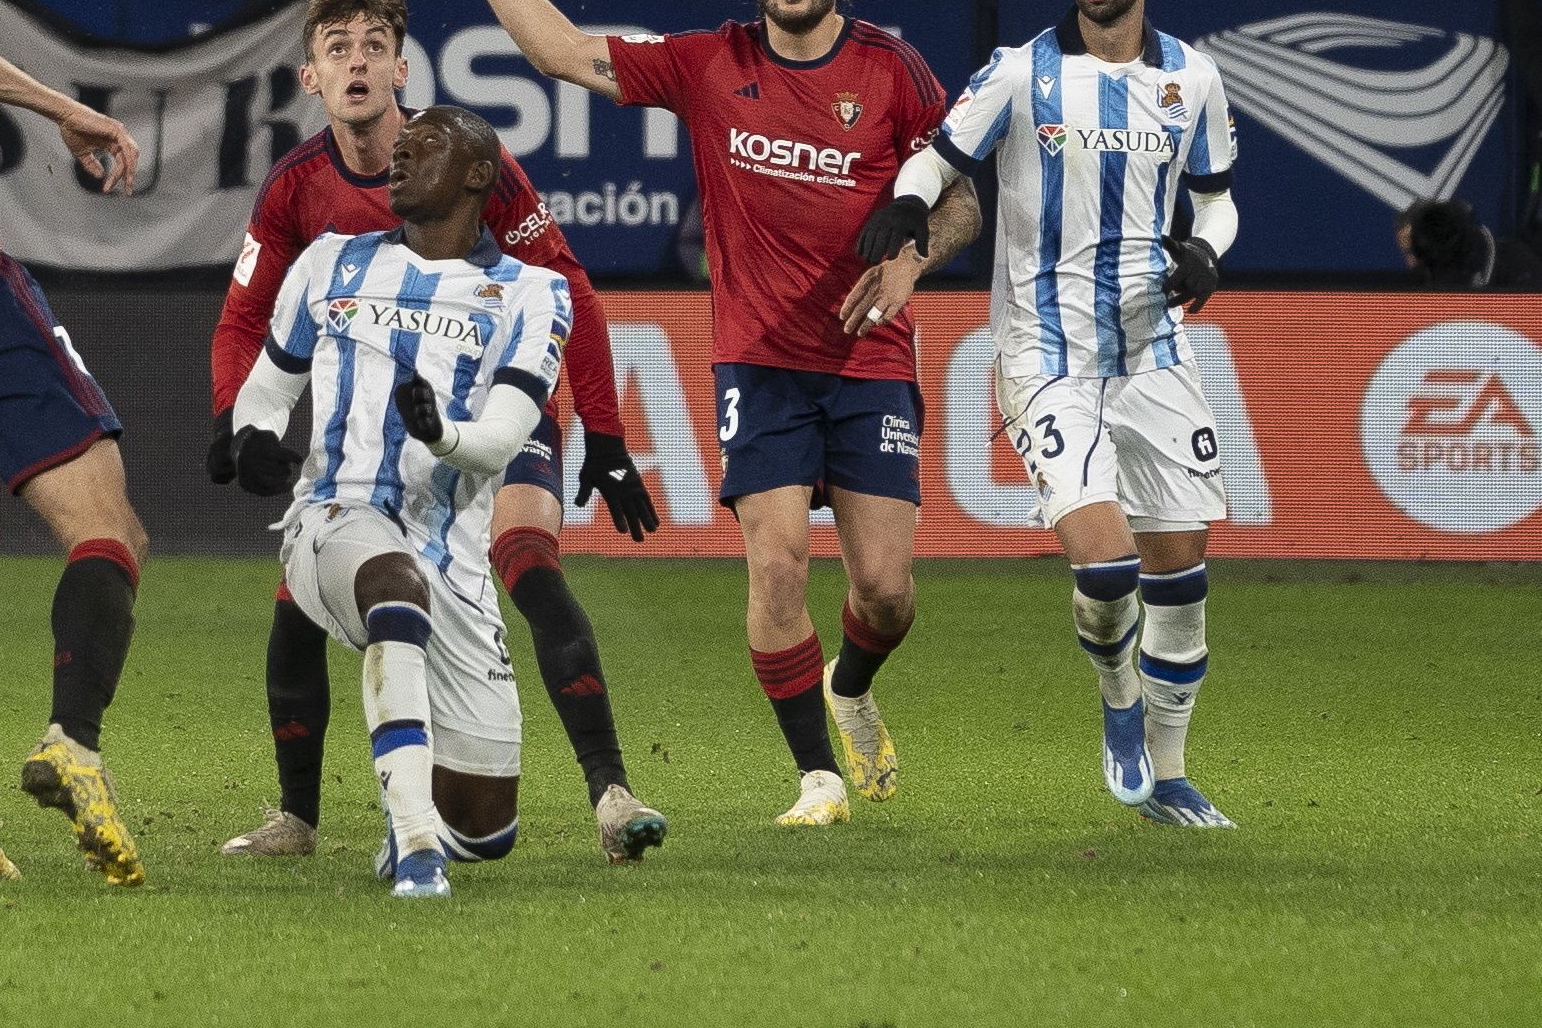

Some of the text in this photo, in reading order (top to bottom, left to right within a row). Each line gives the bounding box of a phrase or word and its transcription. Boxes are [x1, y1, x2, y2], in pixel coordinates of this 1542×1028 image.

[1076, 129, 1174, 153] YASUDA
[753, 163, 856, 188] Climatización eficiente
[369, 303, 482, 347] YASUDA
[719, 387, 741, 442] 3
[1401, 368, 1536, 436] EA
[1396, 442, 1539, 475] SPORTS
